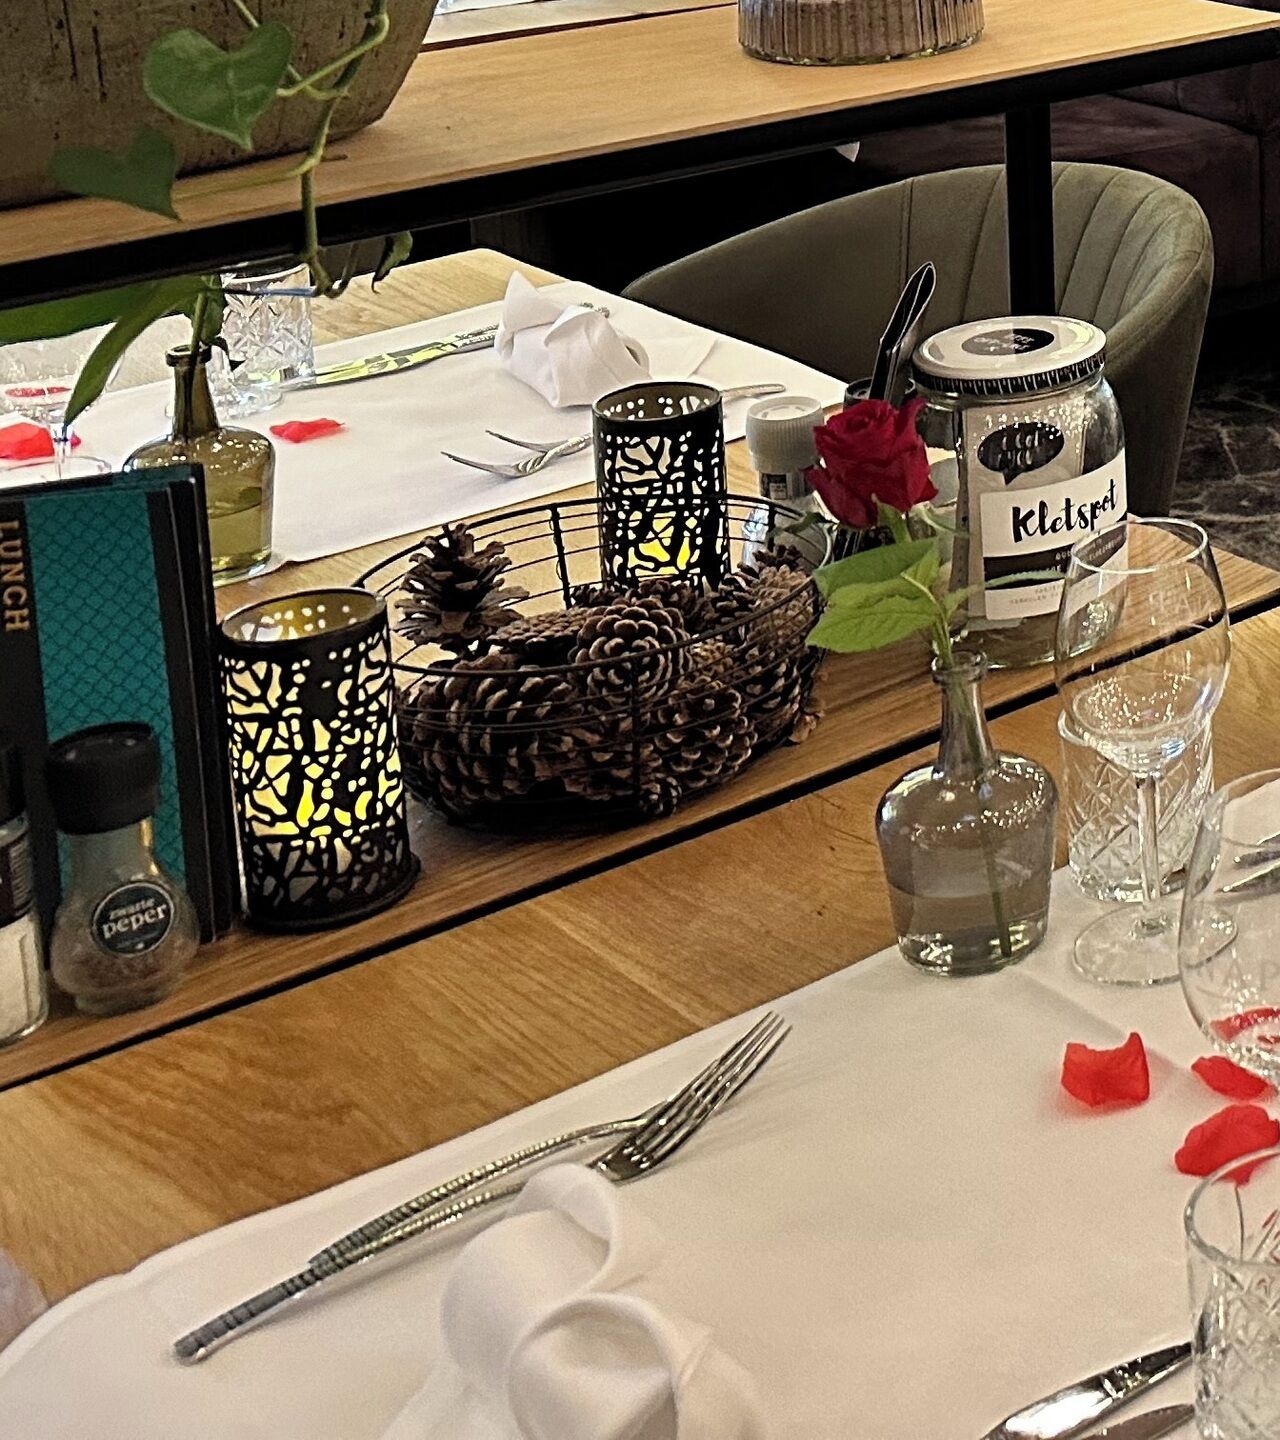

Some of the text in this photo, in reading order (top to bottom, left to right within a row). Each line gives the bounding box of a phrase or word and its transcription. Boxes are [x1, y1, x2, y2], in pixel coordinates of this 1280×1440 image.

[1012, 478, 1118, 543] Kletspot
[0, 520, 30, 633] LUNCH
[102, 904, 167, 939] peper
